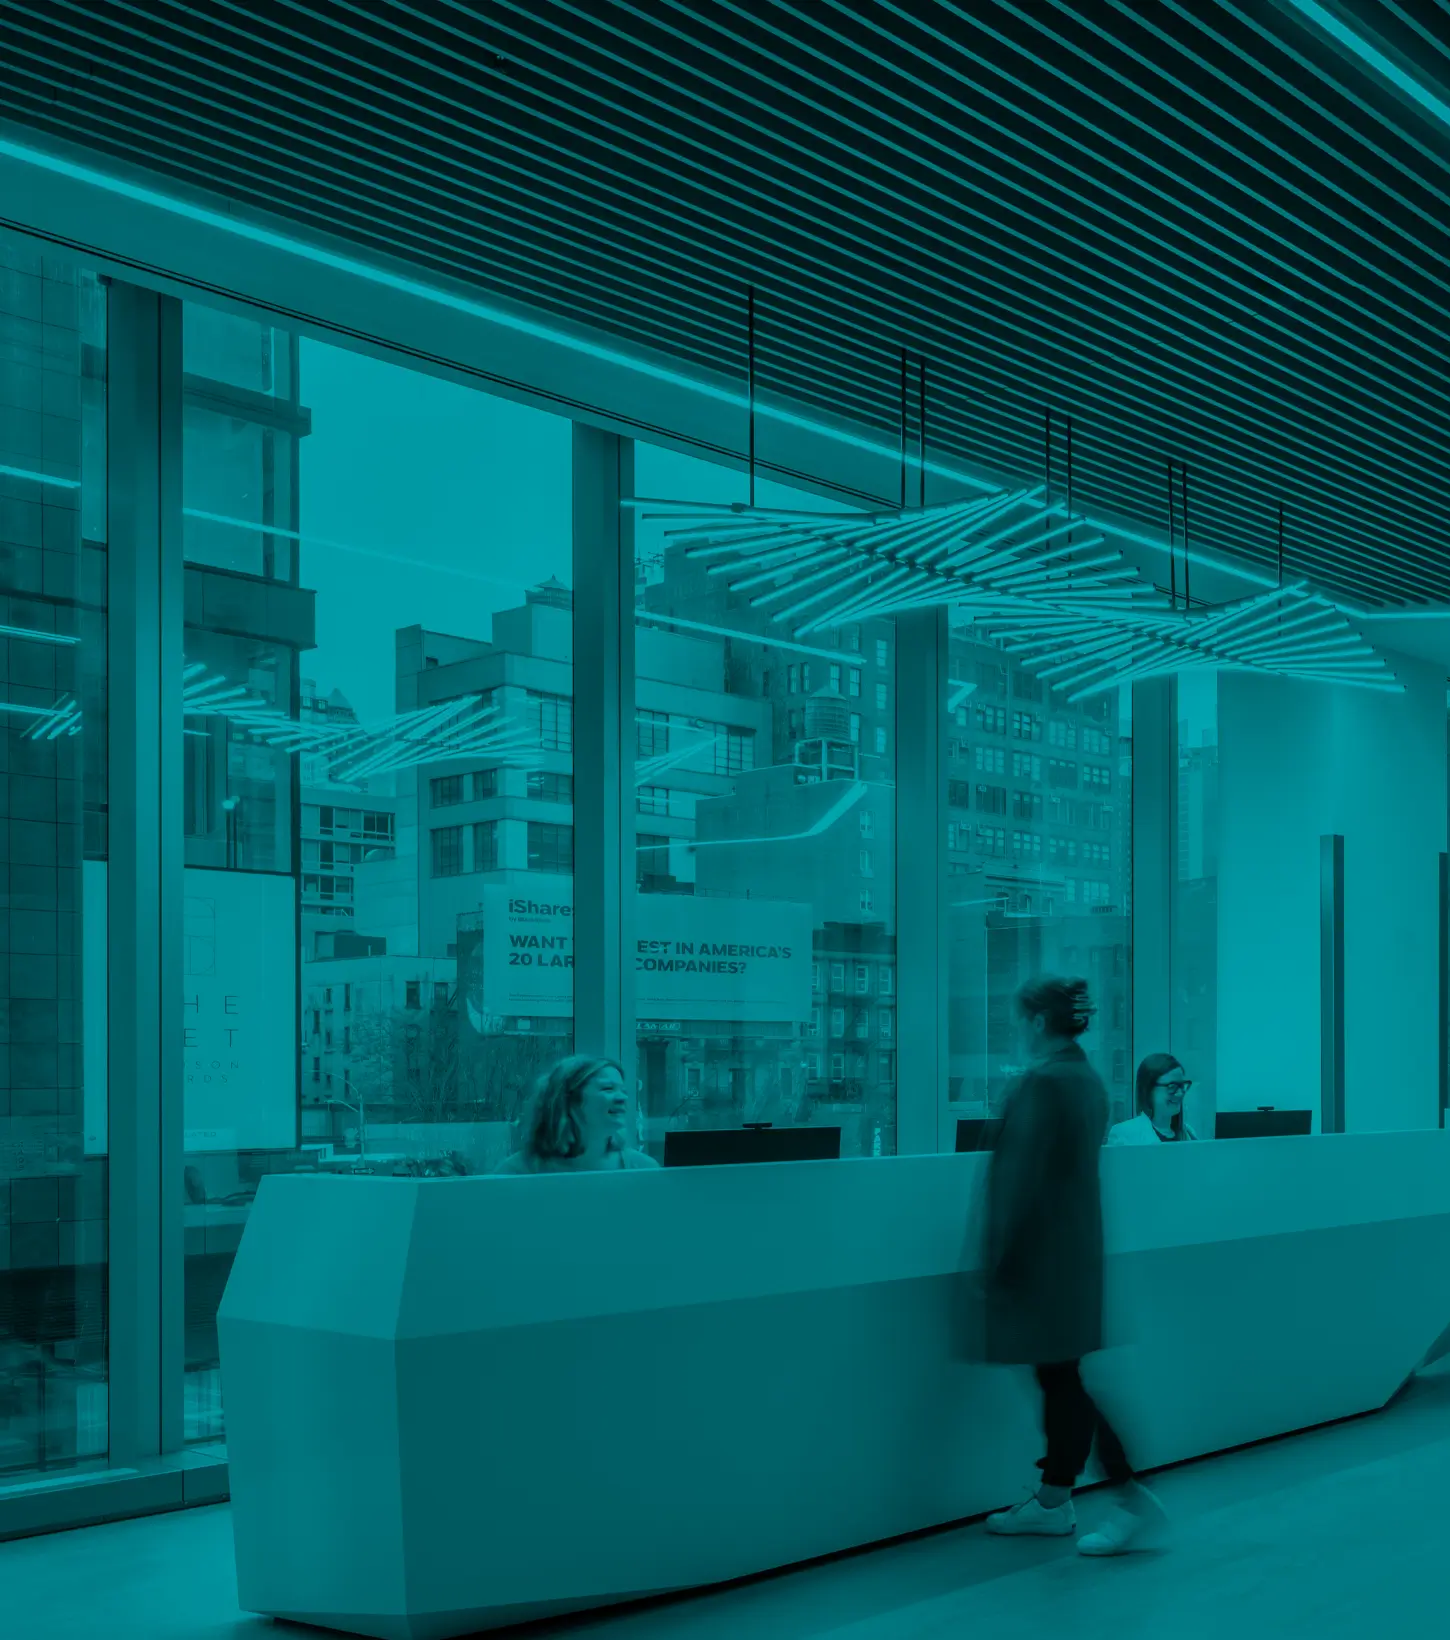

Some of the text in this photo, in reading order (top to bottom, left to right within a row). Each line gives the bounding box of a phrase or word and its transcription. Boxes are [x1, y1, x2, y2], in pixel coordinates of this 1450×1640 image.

[509, 899, 573, 916] iShare
[509, 934, 792, 959] WANT EST IN AMERICA'S
[509, 953, 532, 966] 20
[538, 953, 573, 968] LAR
[184, 994, 239, 1015] HE
[184, 1028, 239, 1048] ET
[184, 1060, 239, 1070] SON
[187, 1074, 228, 1084] RDS
